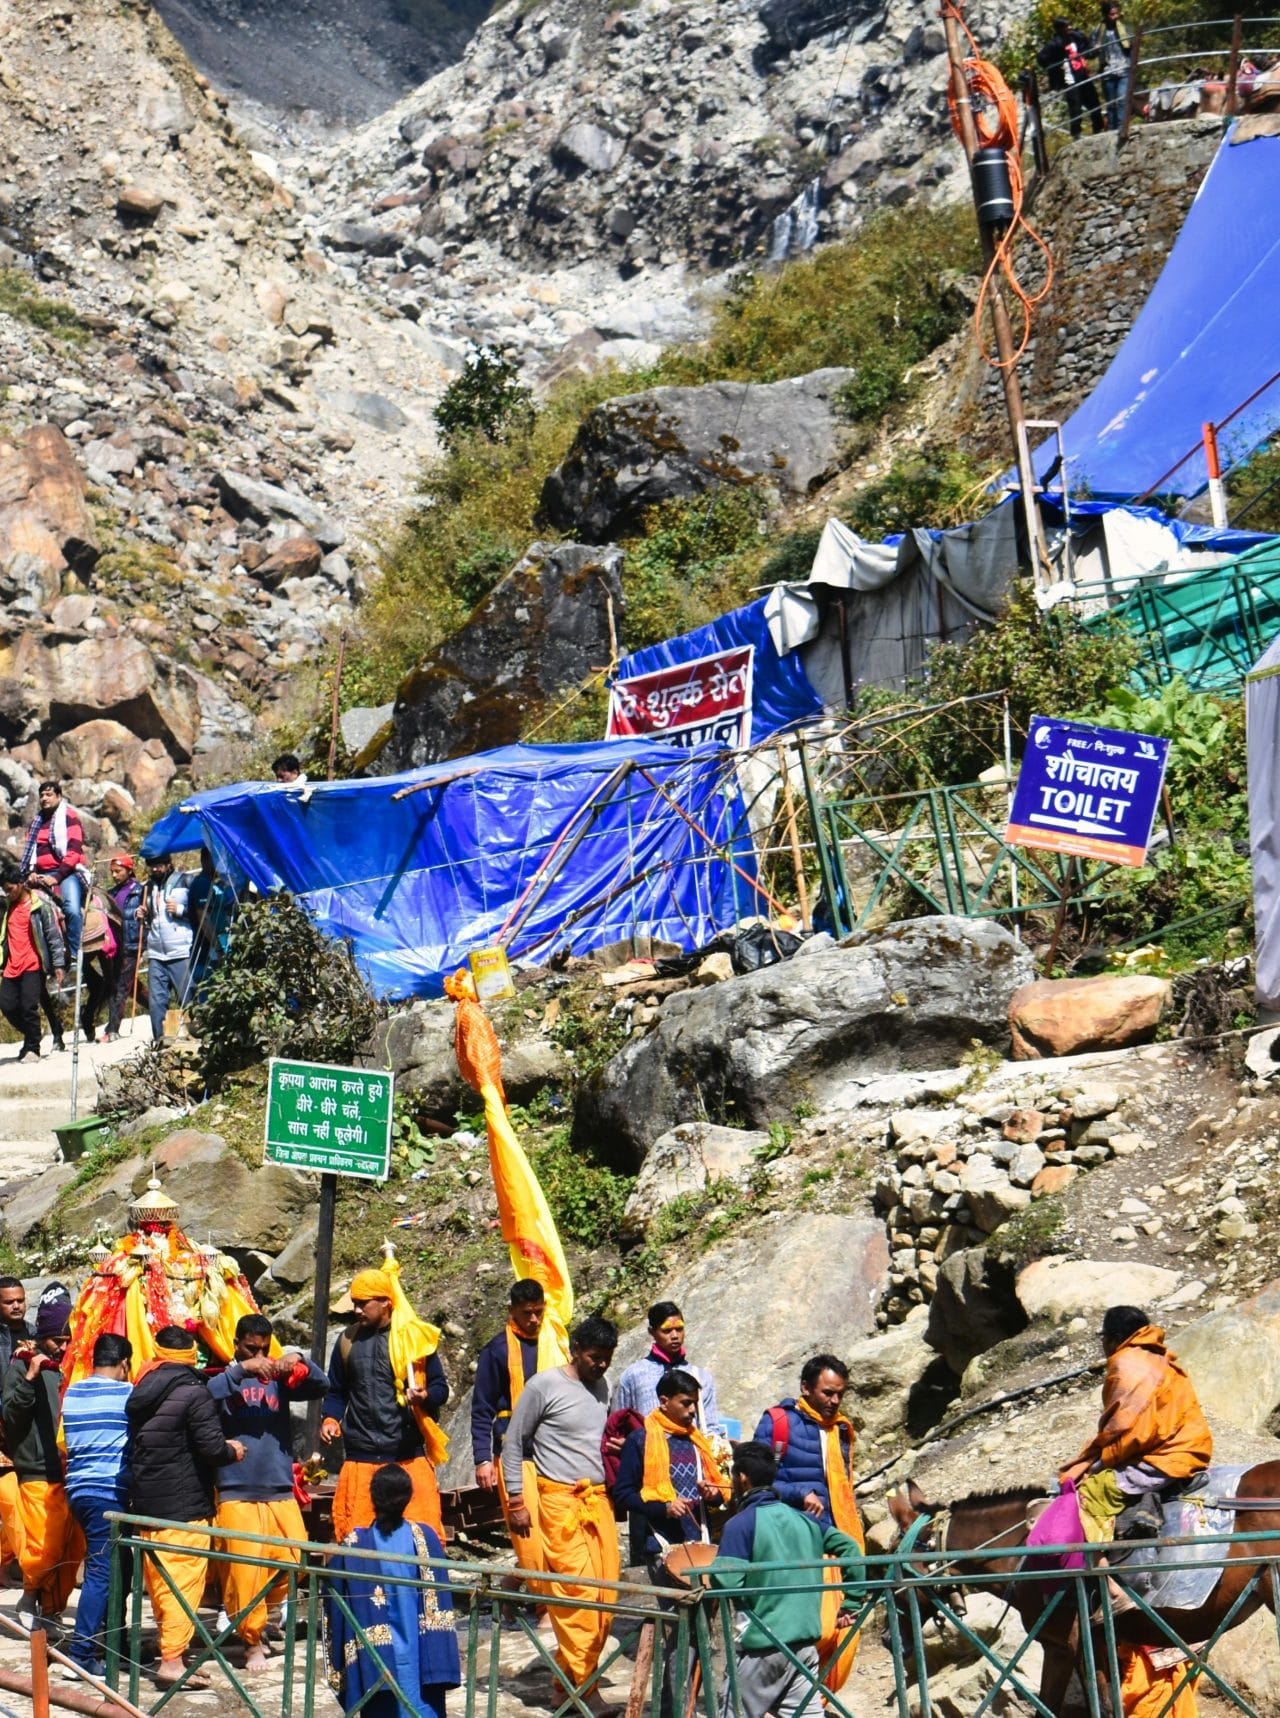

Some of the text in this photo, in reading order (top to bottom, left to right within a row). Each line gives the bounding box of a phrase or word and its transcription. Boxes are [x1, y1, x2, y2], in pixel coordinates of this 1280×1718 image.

[1045, 749, 1140, 794] शौचालय
[1039, 786, 1131, 823] TOILET
[279, 1072, 305, 1090] कृपया
[341, 1078, 364, 1096] करते
[368, 1080, 383, 1103] हुये
[312, 1120, 330, 1140] नहीं
